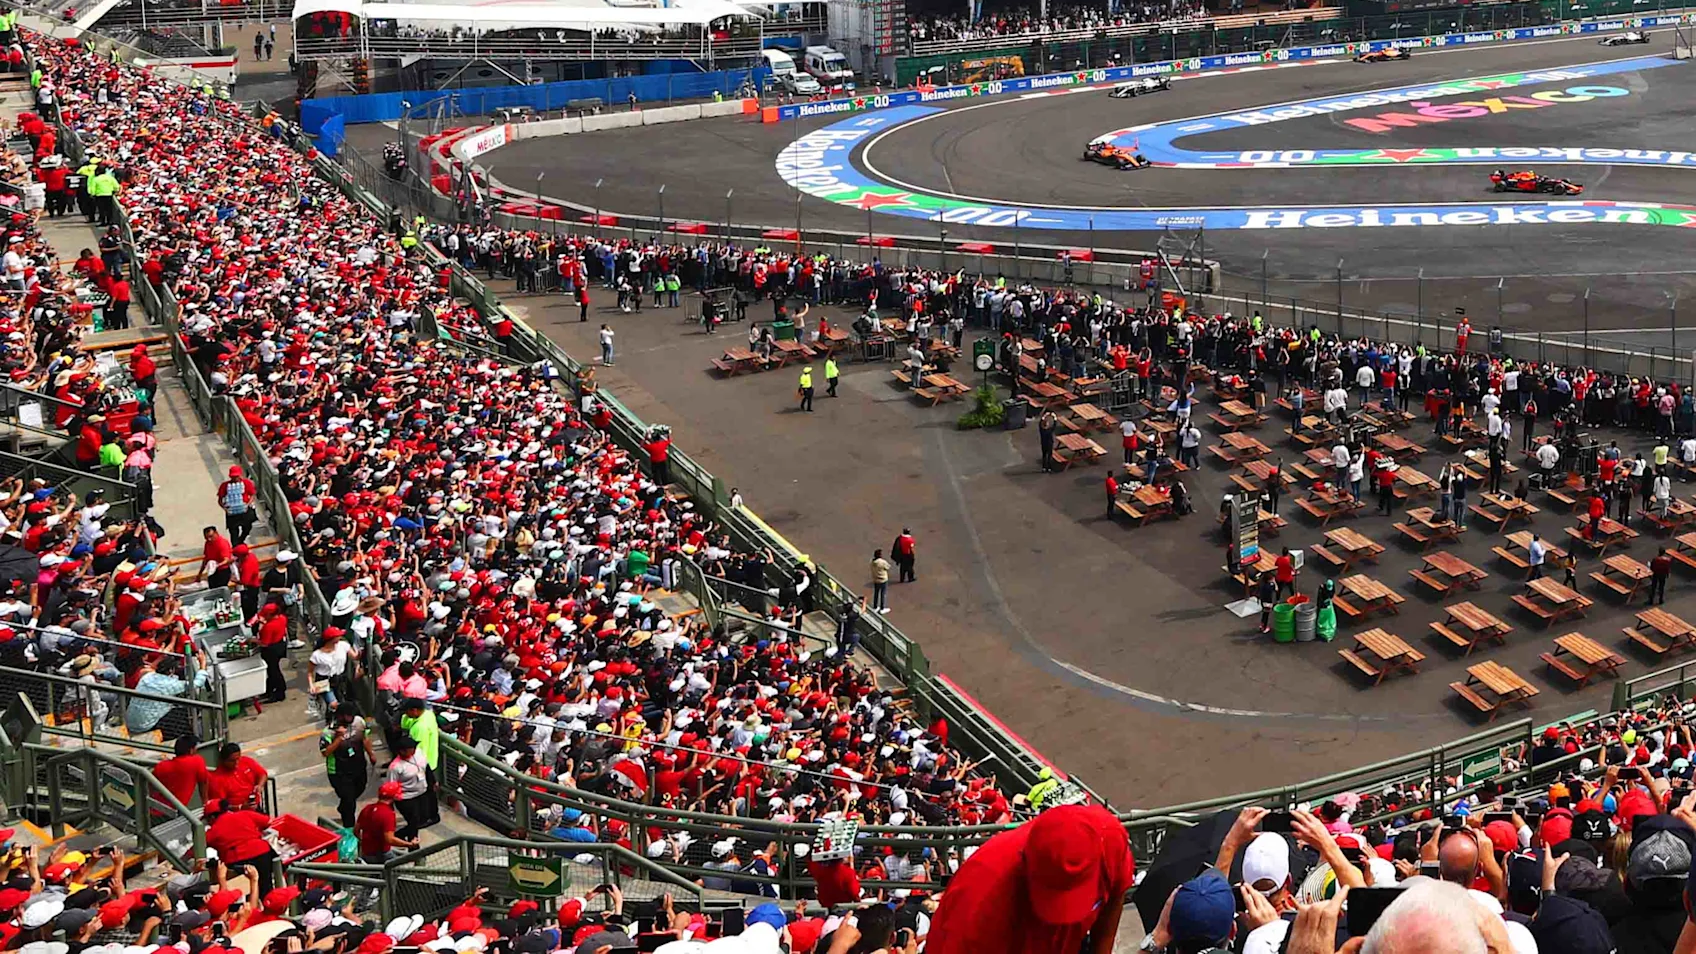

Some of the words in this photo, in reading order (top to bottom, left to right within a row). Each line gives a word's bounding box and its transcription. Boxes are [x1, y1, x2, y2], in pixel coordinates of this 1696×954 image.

[1464, 33, 1494, 44] Heineken
[1533, 27, 1561, 37] Heineken
[1224, 52, 1262, 65] Heineken
[1310, 45, 1345, 58] Heineken
[1132, 63, 1171, 77] Heineken
[1030, 75, 1074, 89] Heineken
[921, 88, 967, 102] Heineken
[799, 101, 851, 117] Heineken
[1233, 86, 1463, 126] Heineken
[1240, 206, 1650, 229] Heineken
